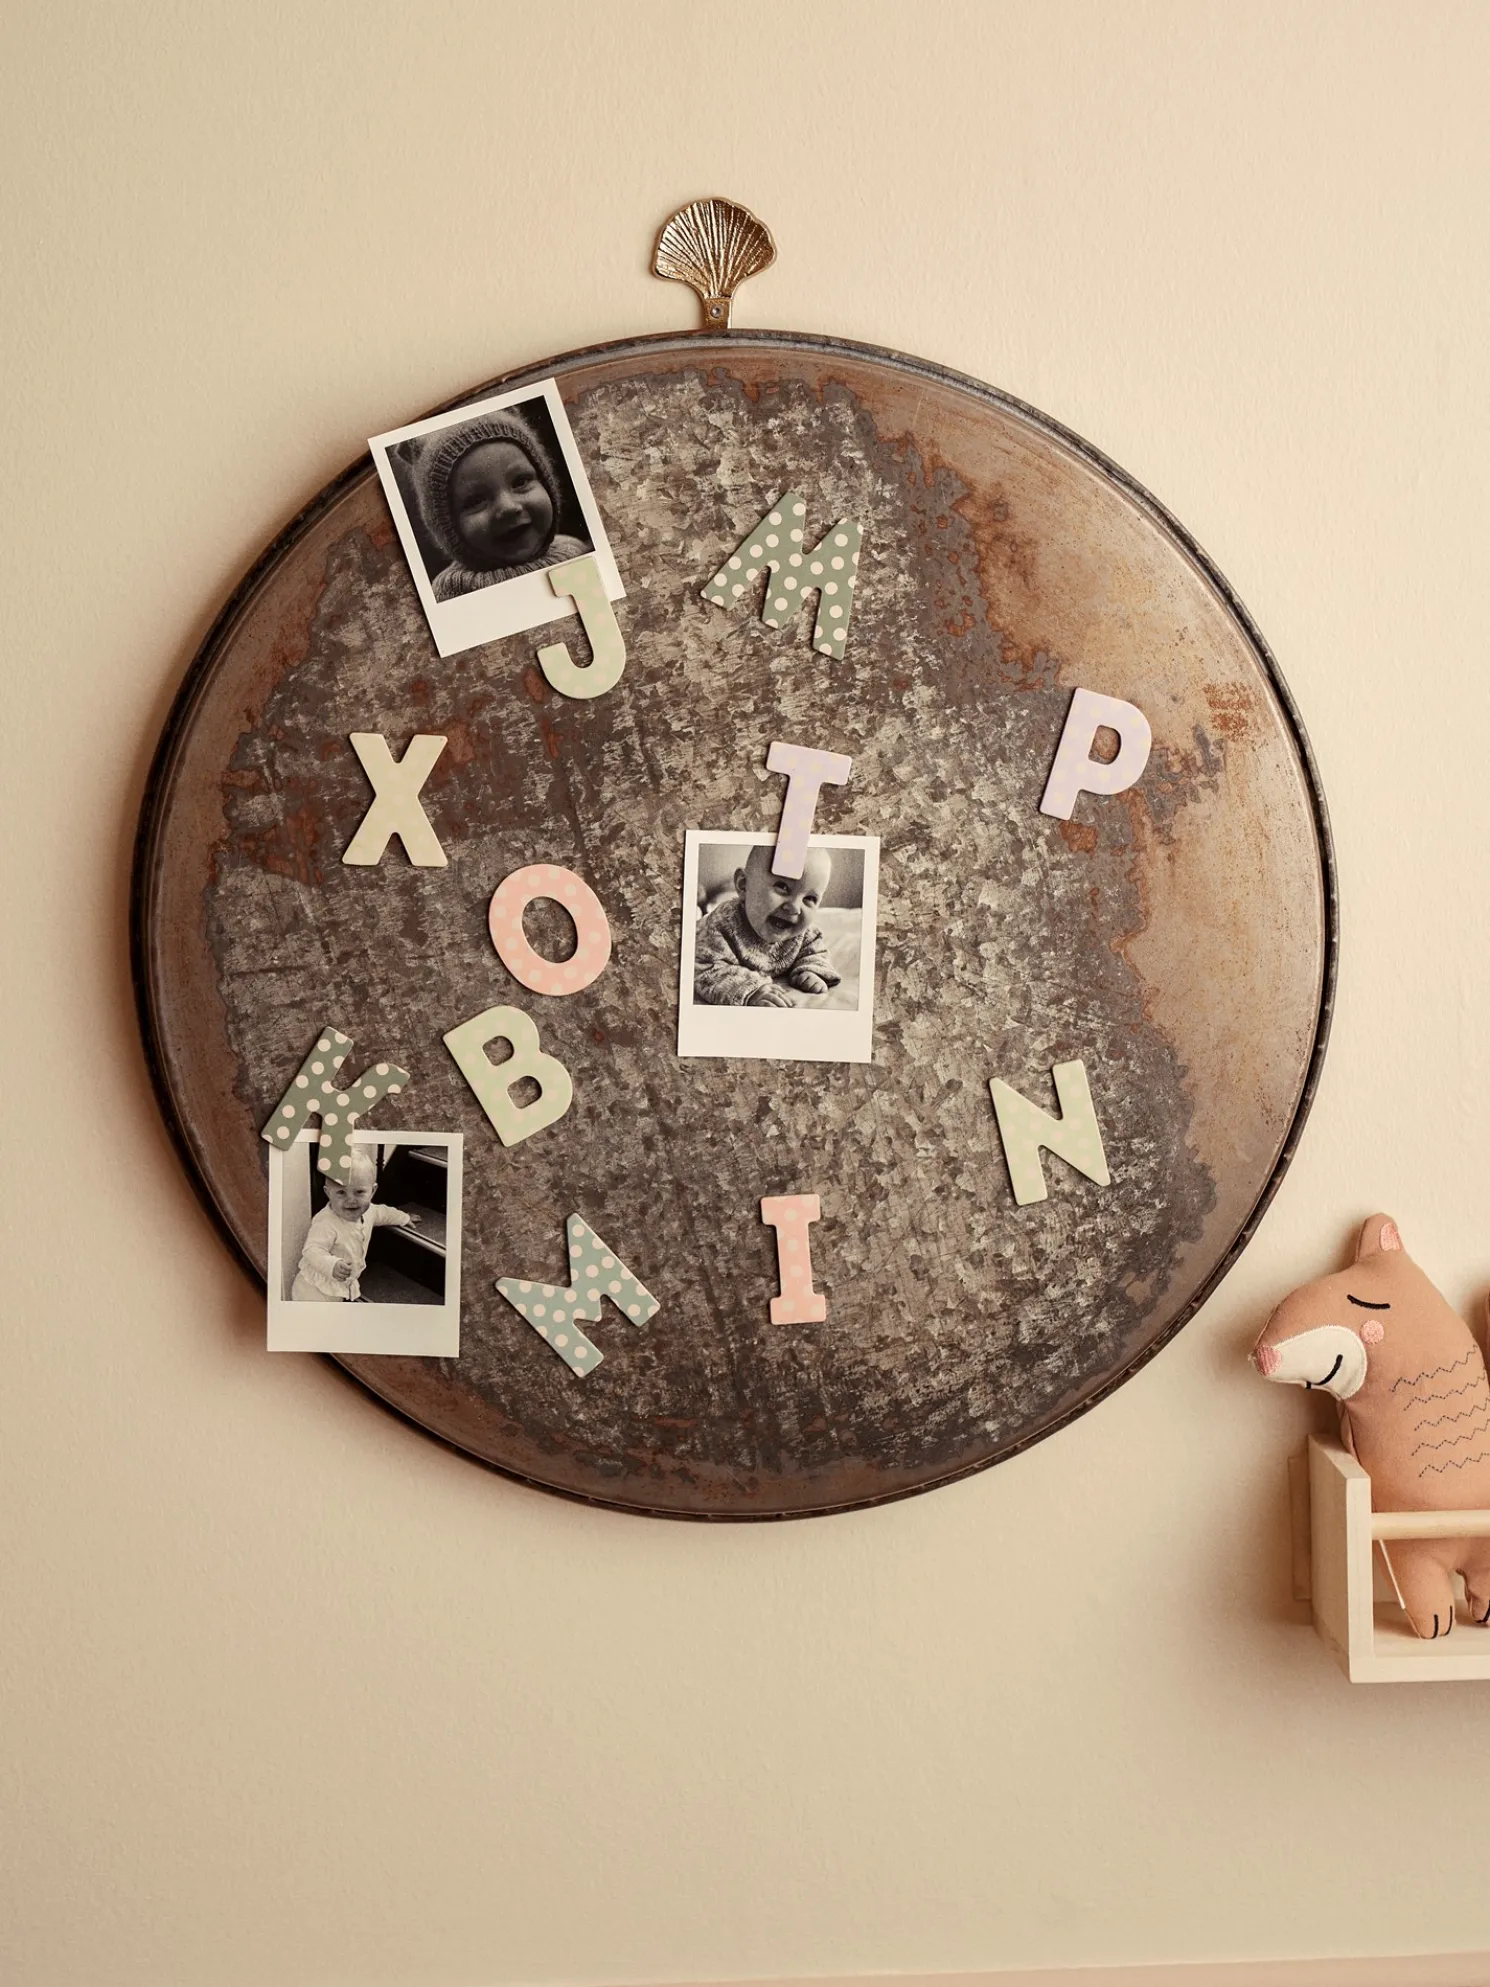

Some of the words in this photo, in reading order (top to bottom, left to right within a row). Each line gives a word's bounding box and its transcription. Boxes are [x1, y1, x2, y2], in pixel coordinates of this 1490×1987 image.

[537, 556, 626, 700] J
[700, 490, 863, 660] M
[342, 732, 448, 867] X
[766, 741, 852, 880] T
[1039, 687, 1152, 820] P
[489, 864, 612, 996] O
[261, 1026, 410, 1185] K
[442, 1005, 573, 1147] B
[989, 1059, 1111, 1206] N
[495, 1212, 660, 1378] M
[760, 1194, 826, 1325] I
